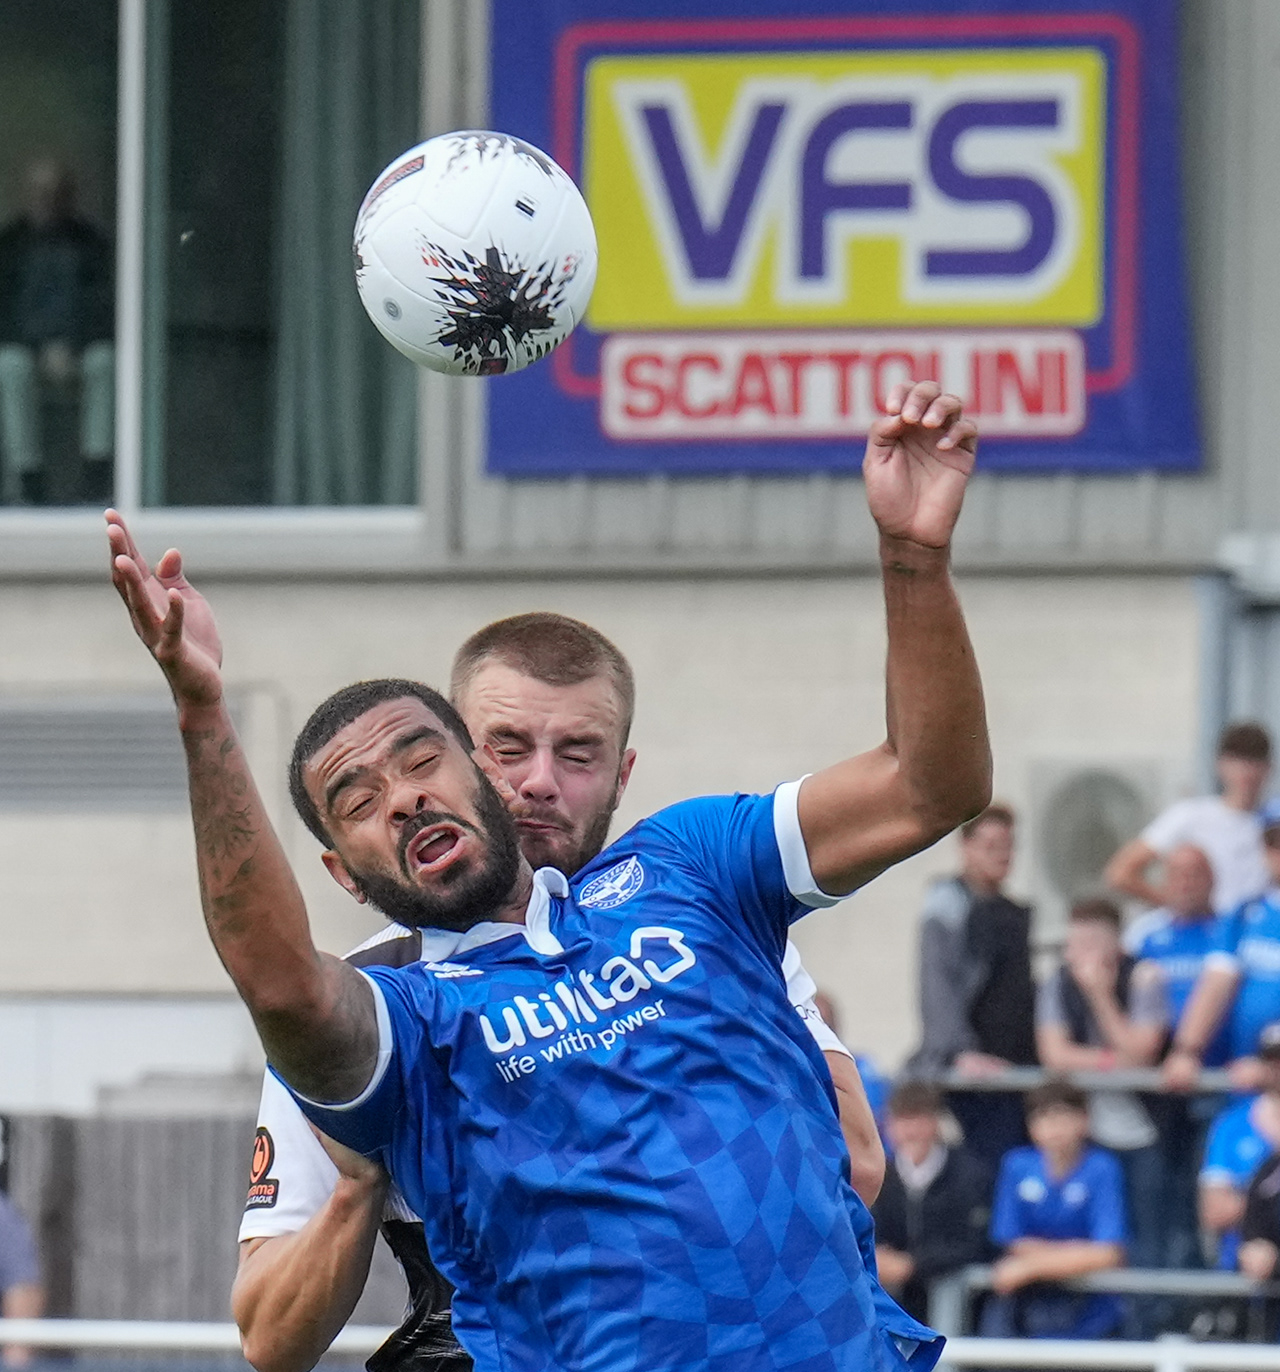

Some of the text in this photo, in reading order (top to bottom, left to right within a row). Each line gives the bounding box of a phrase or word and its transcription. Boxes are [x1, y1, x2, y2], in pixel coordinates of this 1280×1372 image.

[634, 96, 1060, 283] VFS
[479, 956, 652, 1054] utilita
[495, 998, 667, 1084] life with power
